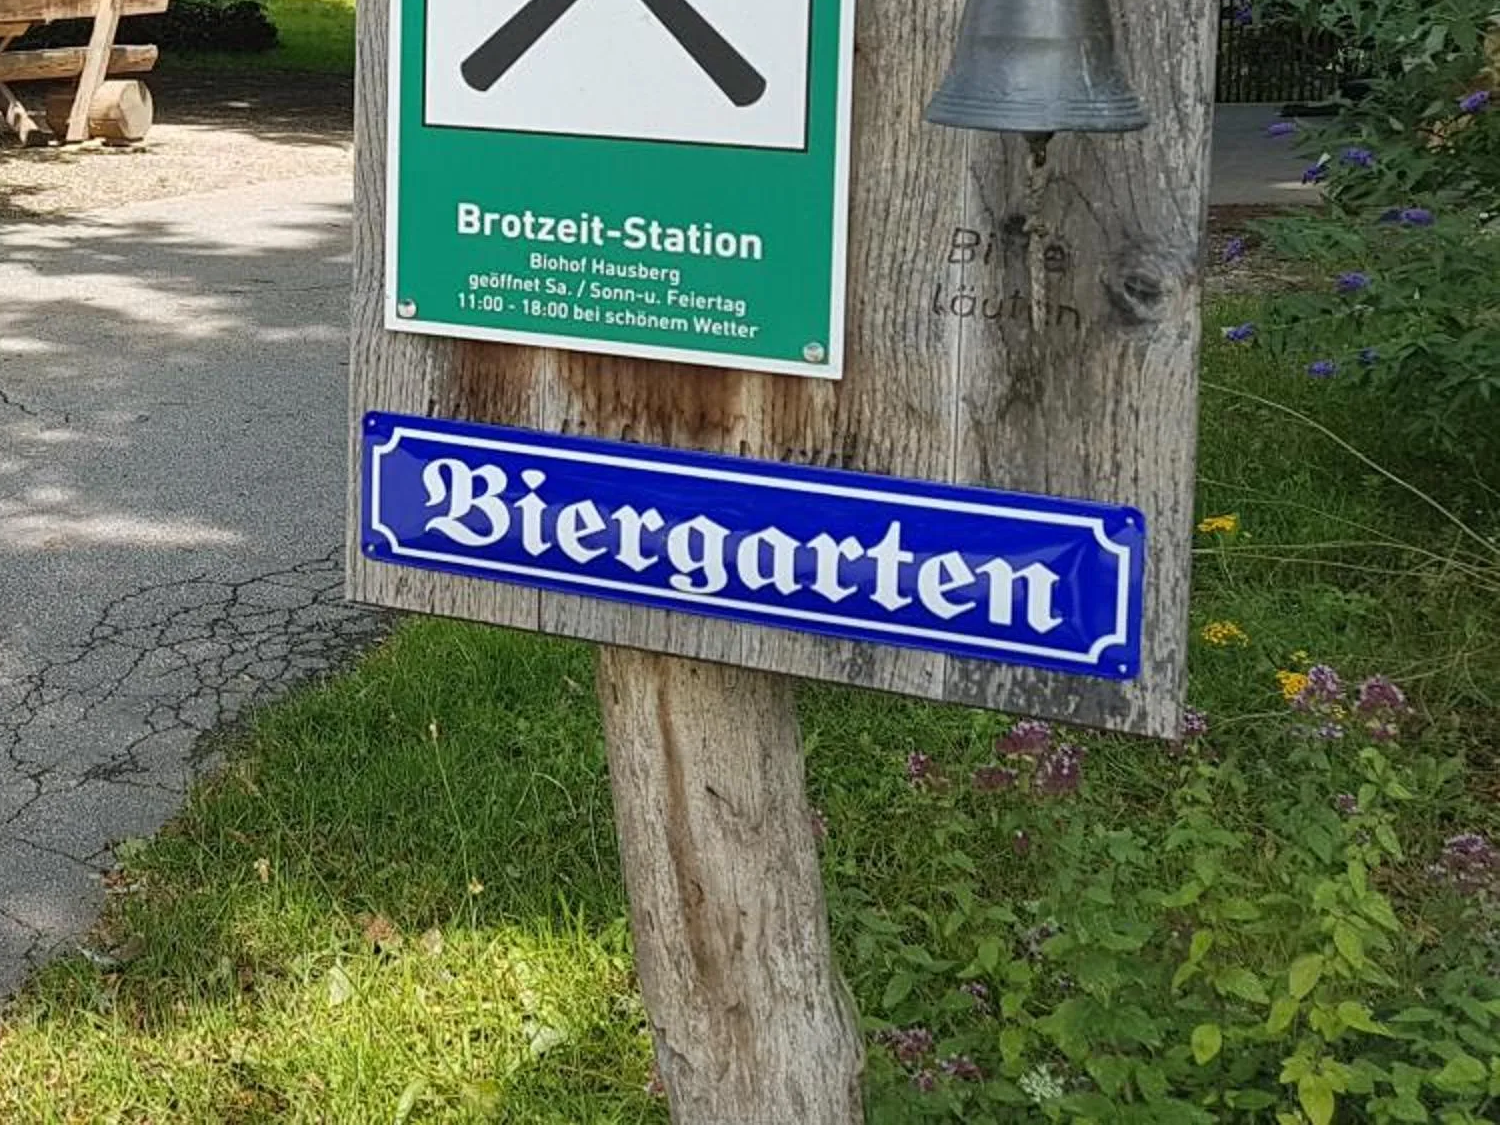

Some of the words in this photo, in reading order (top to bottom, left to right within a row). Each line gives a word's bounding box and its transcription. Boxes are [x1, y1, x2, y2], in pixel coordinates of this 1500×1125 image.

[456, 202, 763, 260] Brotzeit-Station
[948, 227, 1066, 274] Bie
[529, 252, 587, 273] Biohof
[591, 258, 681, 286] Hausberg
[458, 292, 503, 312] 11:00
[522, 299, 568, 318] 18:00
[573, 303, 600, 322] bei
[605, 308, 688, 332] schönem
[693, 315, 760, 338] Wetter
[468, 272, 540, 292] geöffnet
[545, 278, 572, 296] Sa.
[576, 279, 586, 298] /
[667, 290, 746, 317] Feiertag
[421, 457, 1064, 634] Biergarten
